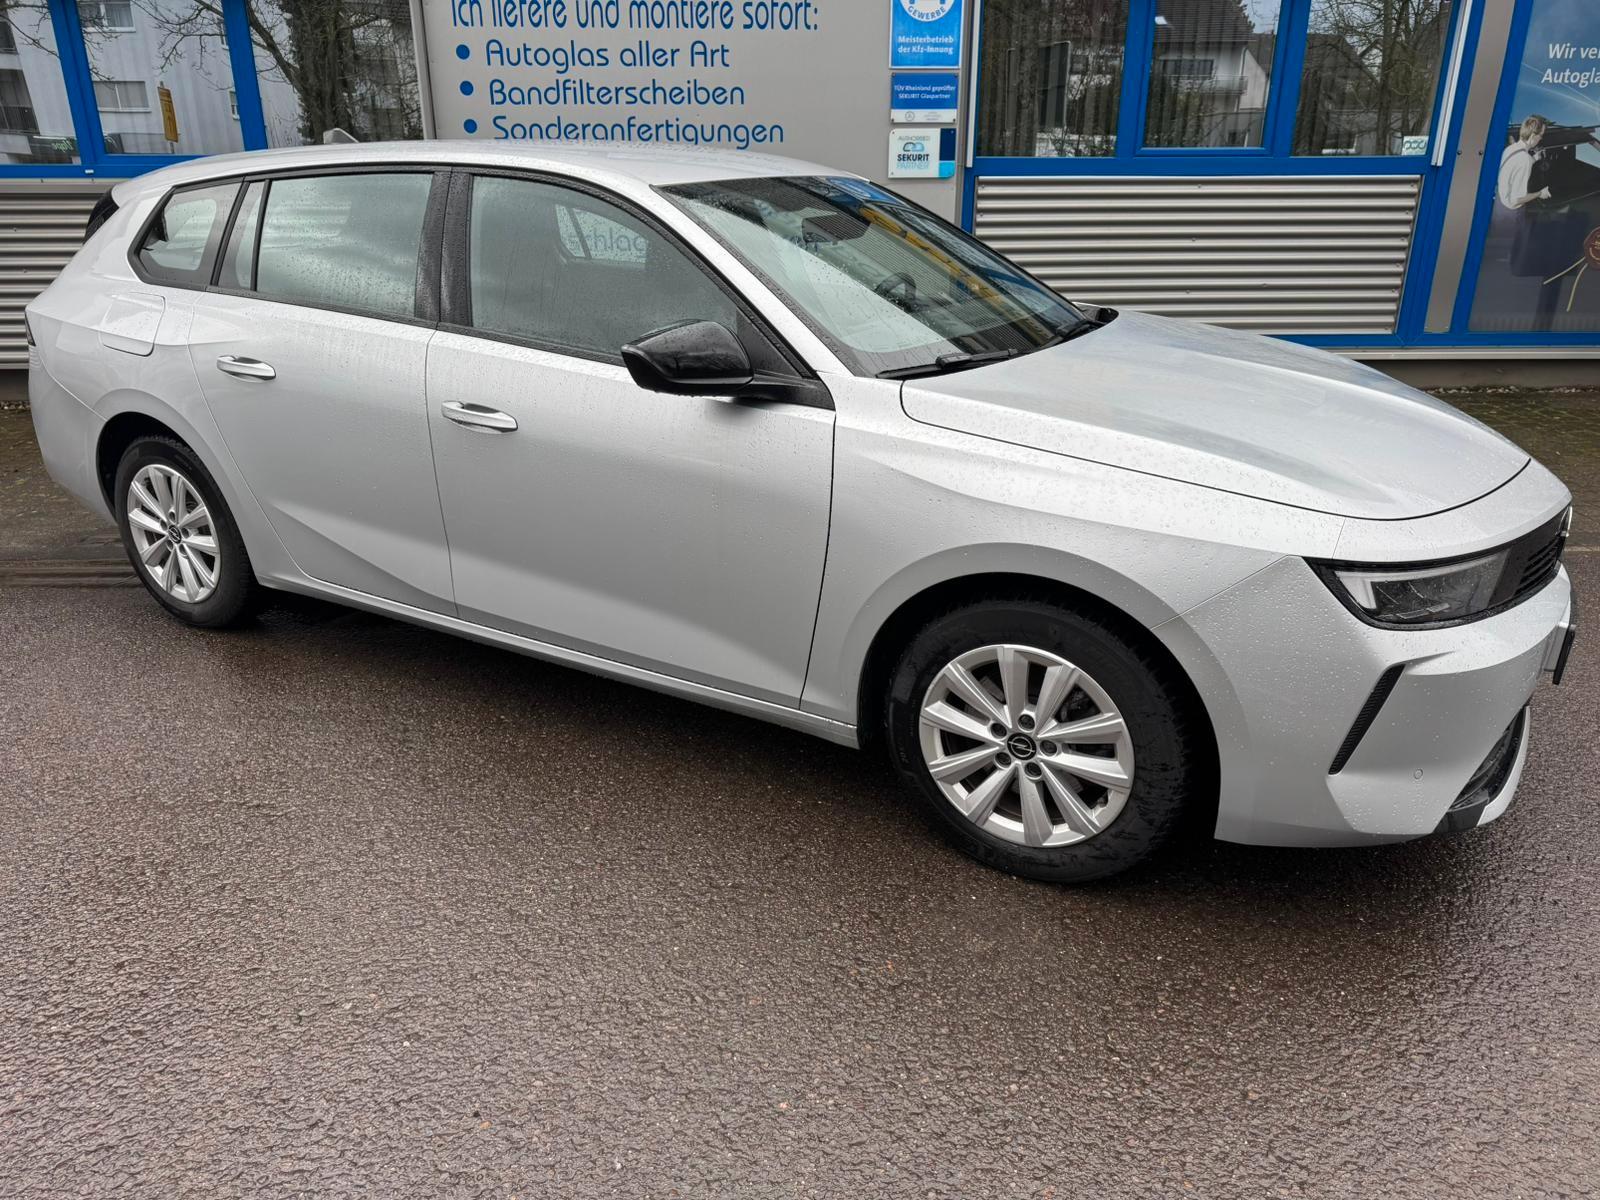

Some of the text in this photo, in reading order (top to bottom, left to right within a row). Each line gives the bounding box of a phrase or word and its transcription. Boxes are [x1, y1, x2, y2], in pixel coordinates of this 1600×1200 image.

[452, 0, 818, 30] Ich liefere und montiere sofort:
[908, 5, 946, 20] GEWERBE
[897, 35, 954, 43] Meisterbetrieb
[486, 39, 730, 74] Autoglas aller Art
[1548, 43, 1600, 59] Wir ve
[489, 78, 745, 105] Bandfilterscheiben
[492, 115, 784, 149] Sonderanfertigungen
[897, 153, 930, 162] SEKURIT
